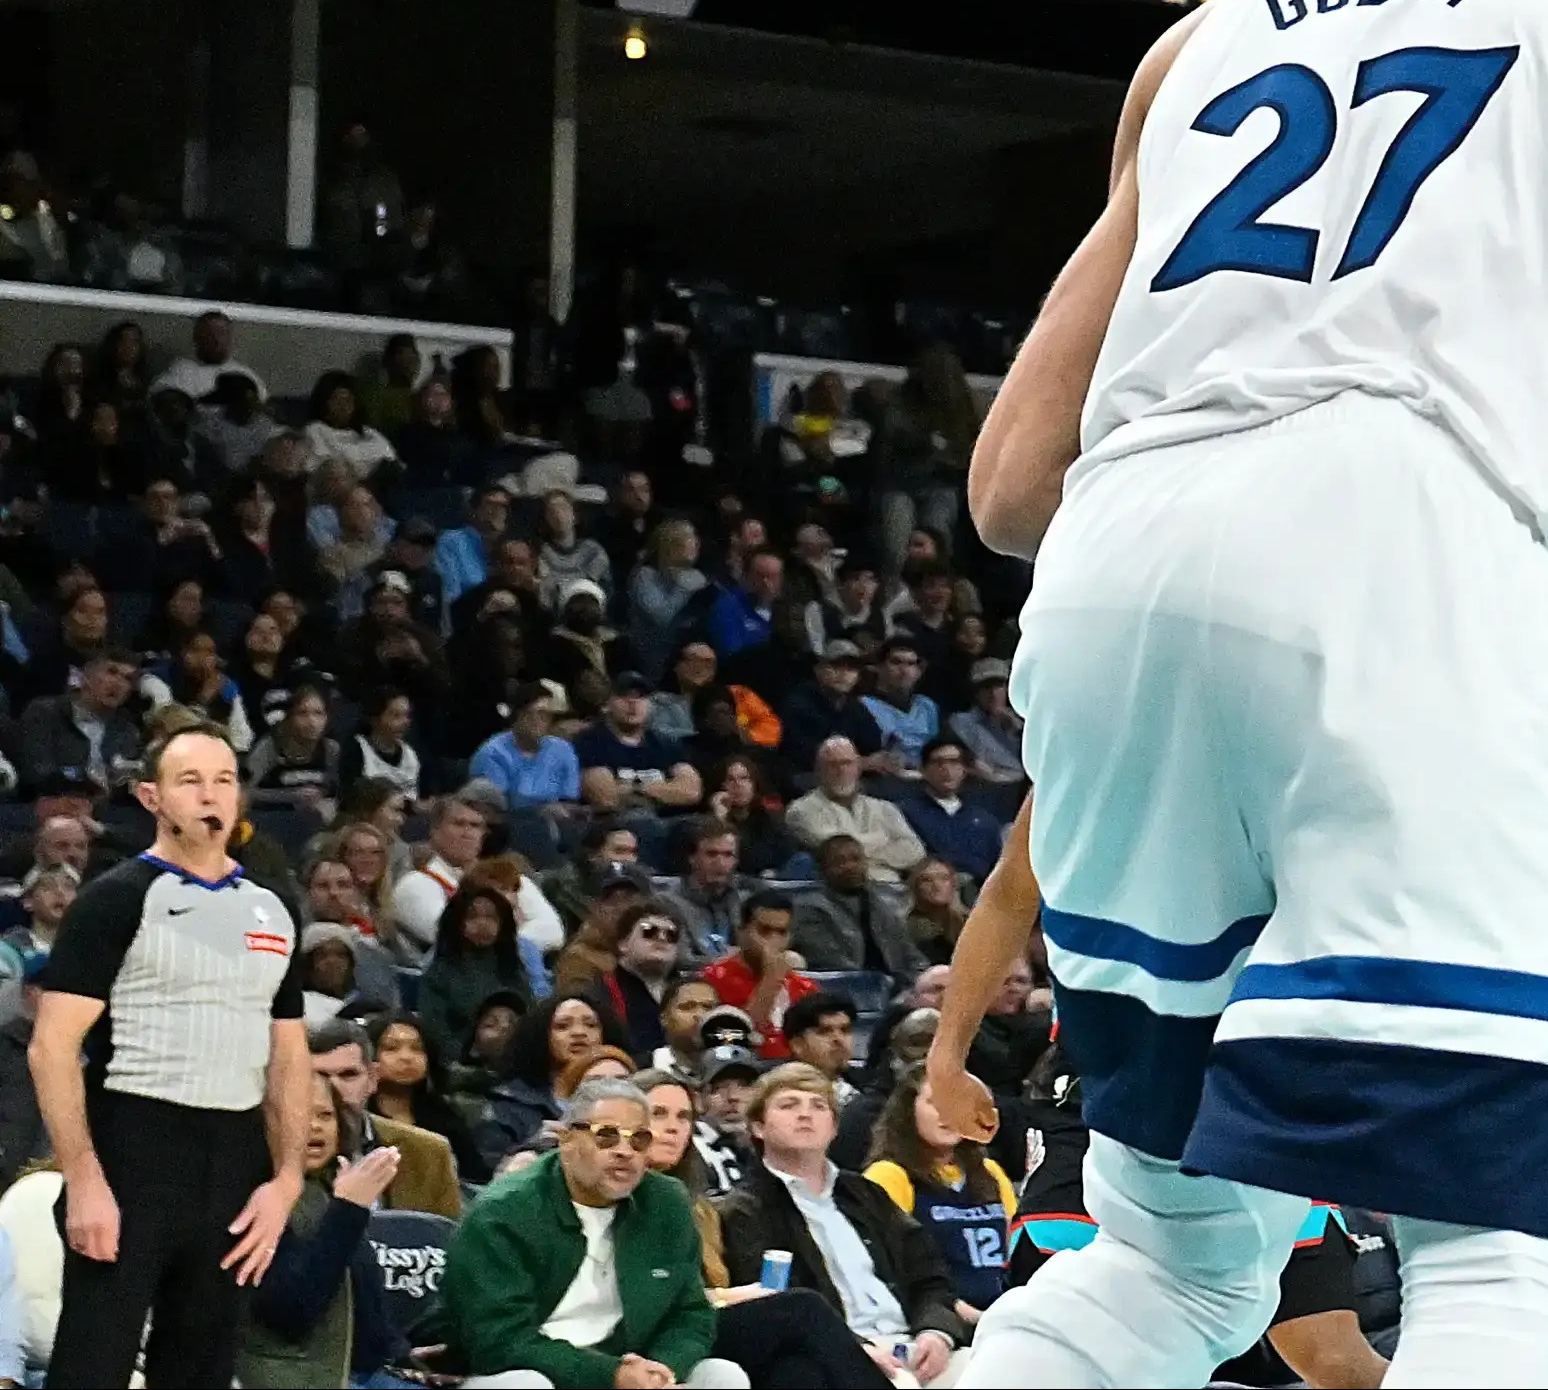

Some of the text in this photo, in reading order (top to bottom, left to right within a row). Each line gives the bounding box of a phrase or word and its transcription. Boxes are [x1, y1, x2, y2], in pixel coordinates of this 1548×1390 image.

[1149, 45, 1521, 293] 27
[368, 1240, 448, 1275] issy's
[963, 1227, 1005, 1268] 12
